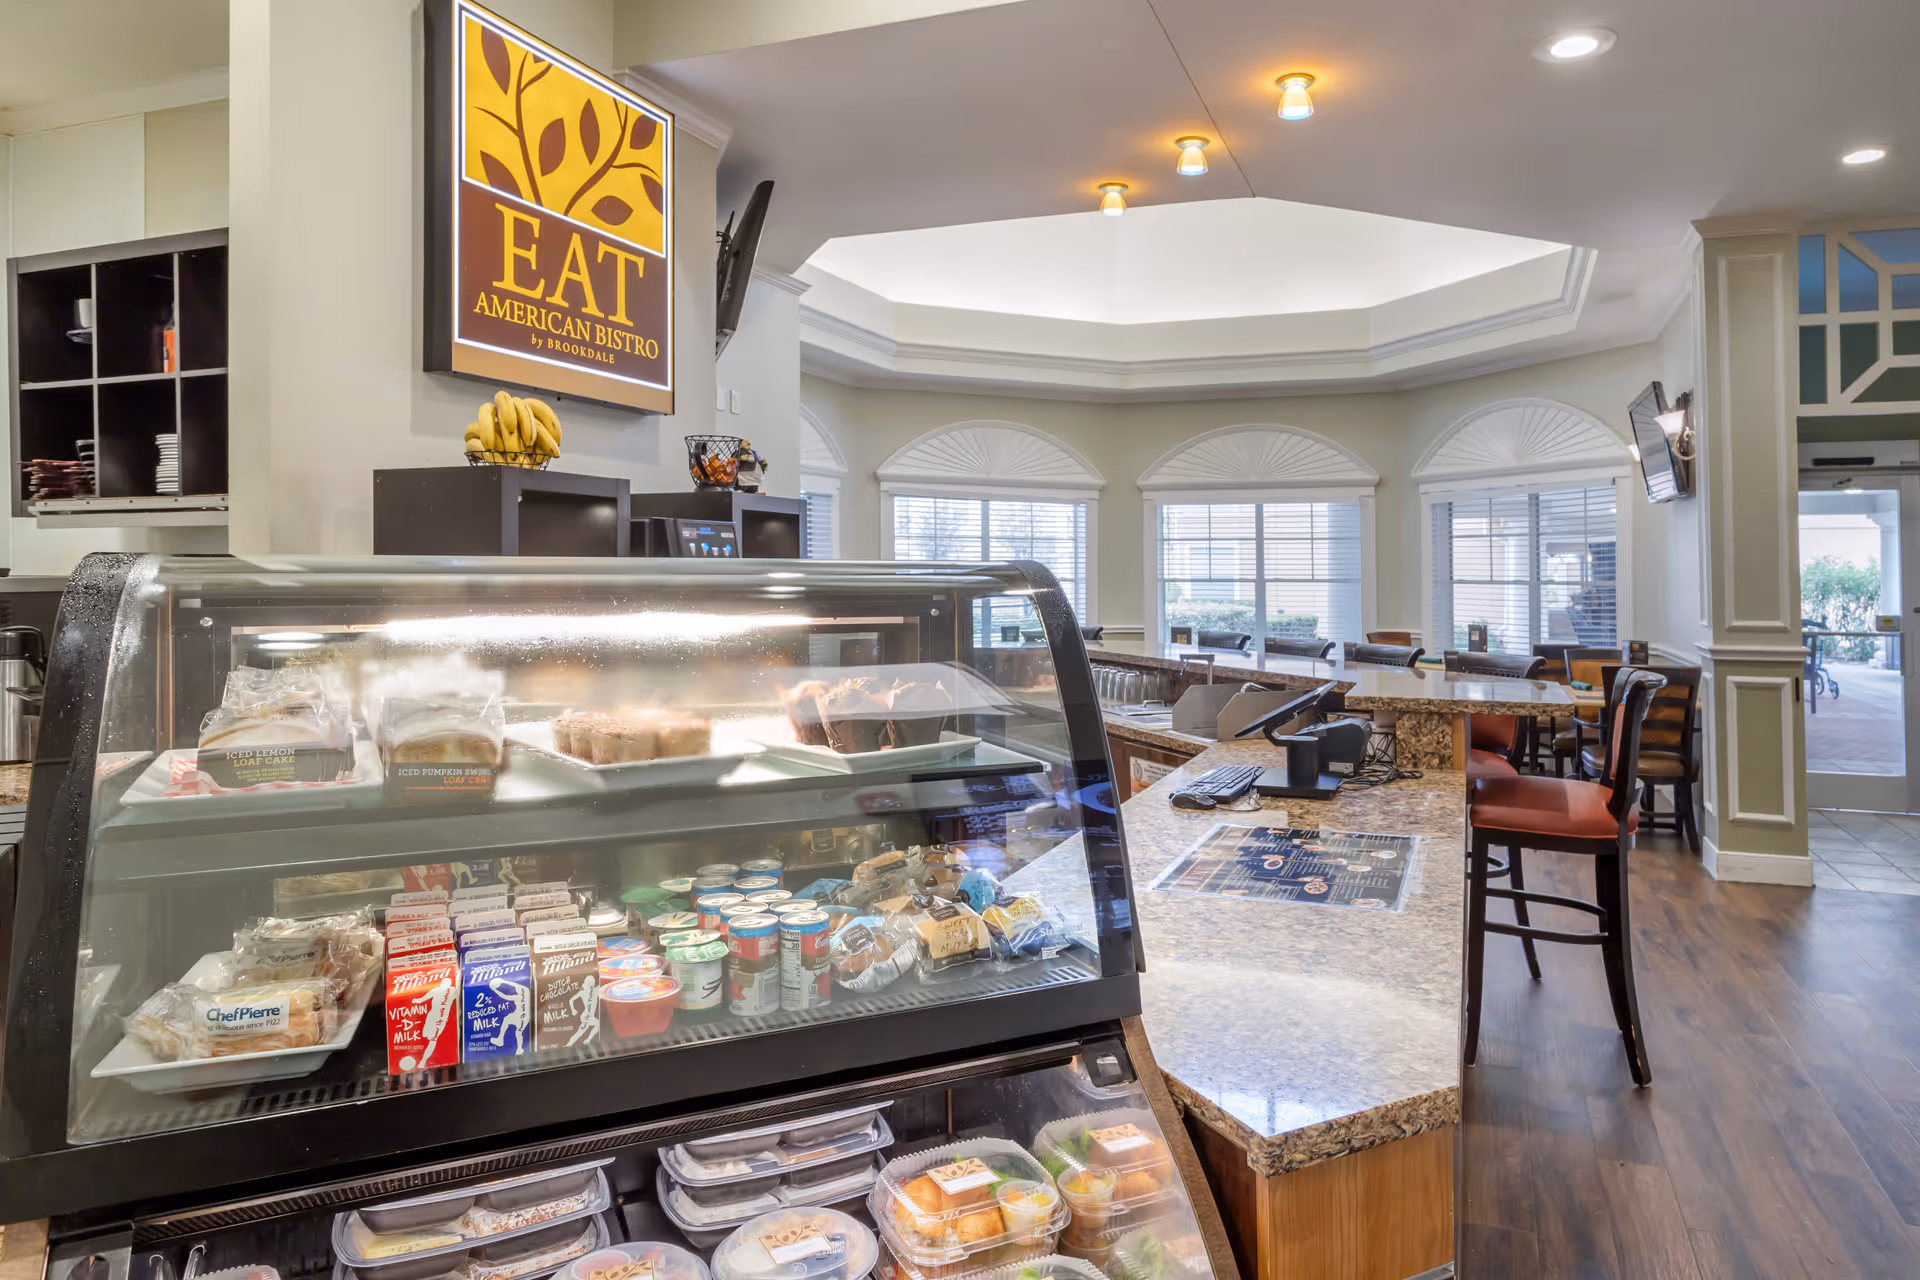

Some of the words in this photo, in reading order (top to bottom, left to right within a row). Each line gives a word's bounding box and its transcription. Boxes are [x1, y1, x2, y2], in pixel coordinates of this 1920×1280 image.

[492, 202, 645, 327] EAT
[473, 291, 591, 342] AMERICAN
[594, 323, 659, 360] BISTRO
[531, 333, 543, 348] by
[547, 338, 615, 364] BROOKDALE
[226, 750, 253, 759] ICED
[256, 748, 295, 757] LEMON
[233, 758, 263, 767] LOAF
[265, 755, 295, 764] CAKE
[398, 768, 420, 776] ICED
[422, 768, 463, 776] PUMPKIN
[937, 917, 970, 930] SWEET
[542, 951, 595, 976] Hiland
[469, 960, 527, 984] Hiland
[392, 967, 451, 995] Hiland
[548, 976, 571, 991] DUTCH
[475, 992, 492, 1008] 2%
[540, 982, 580, 1002] CHOCOLATE
[389, 1003, 428, 1020] VITAMIN
[467, 1006, 497, 1020] REDUCED
[498, 1001, 510, 1012] FAT
[543, 1008, 569, 1024] MILK
[265, 1018, 281, 1026] 1922
[473, 1017, 500, 1031] MILK
[393, 1030, 421, 1044] MILK
